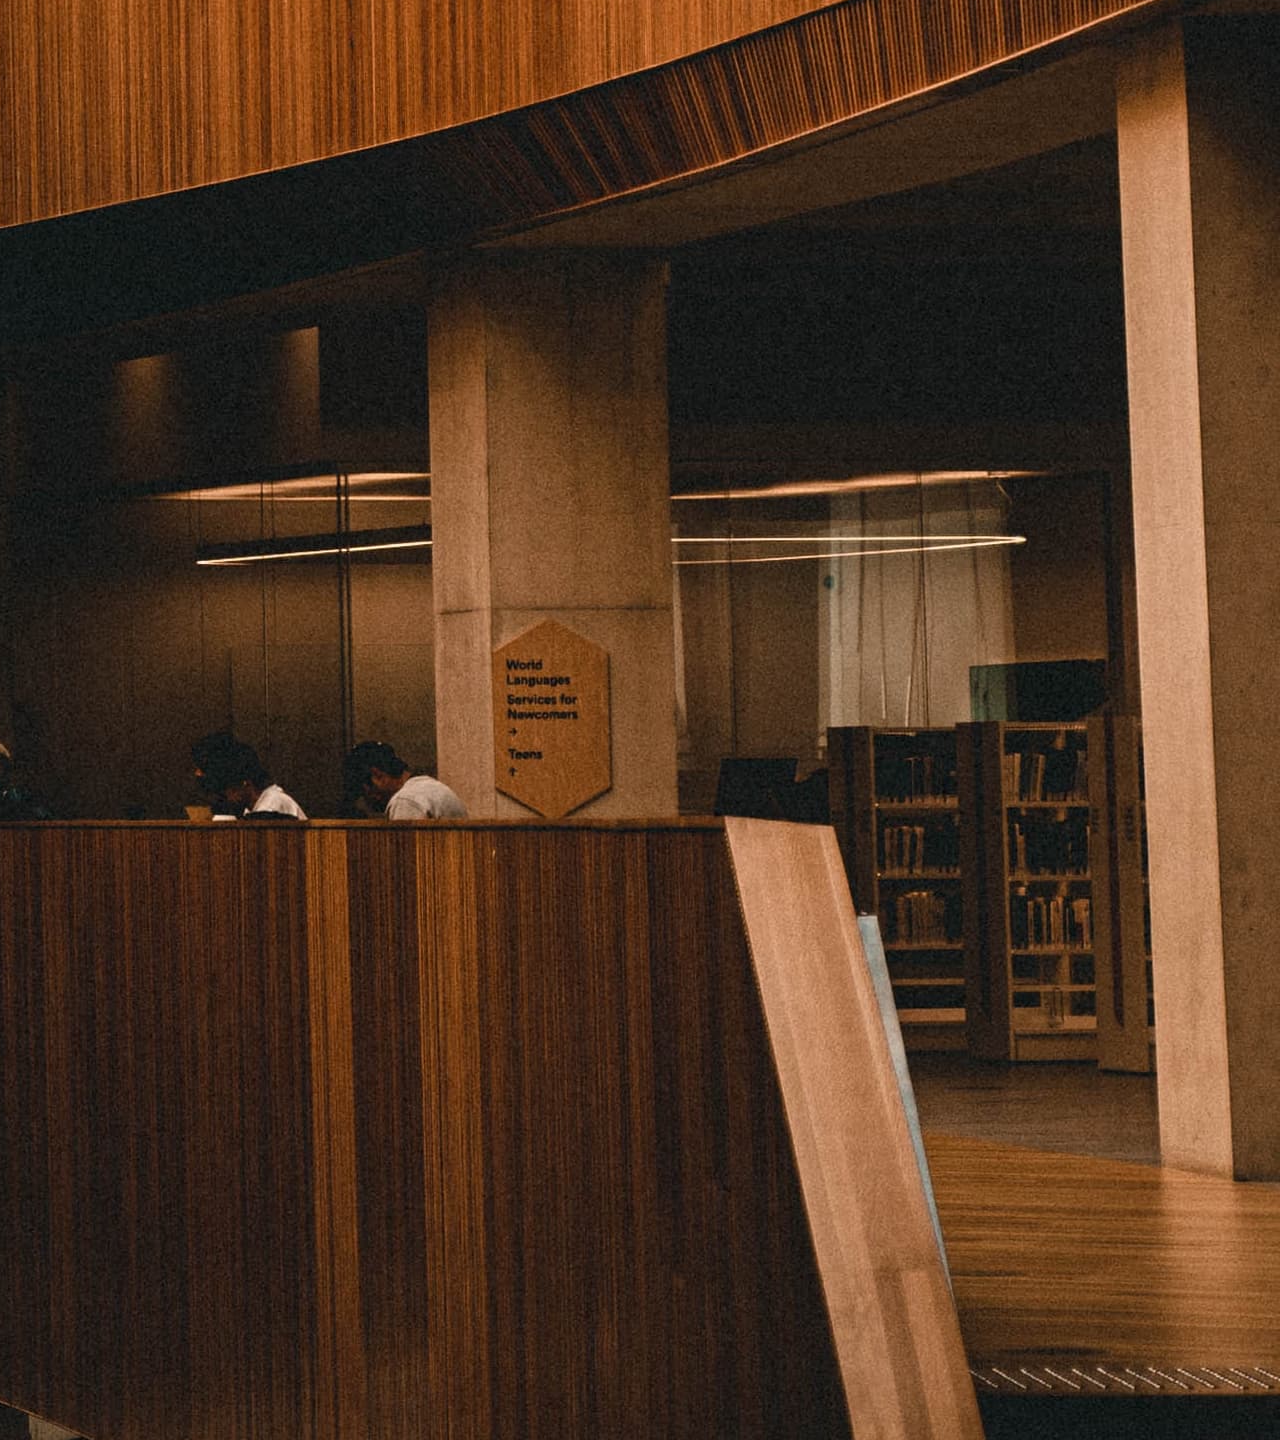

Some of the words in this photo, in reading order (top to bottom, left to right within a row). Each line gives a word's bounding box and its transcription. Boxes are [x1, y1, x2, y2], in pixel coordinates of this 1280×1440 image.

[506, 659, 543, 670] World
[506, 675, 571, 687] Languages
[507, 694, 557, 705] Services
[560, 693, 578, 705] for
[507, 709, 578, 720] Newcomers
[508, 748, 543, 760] Teens
